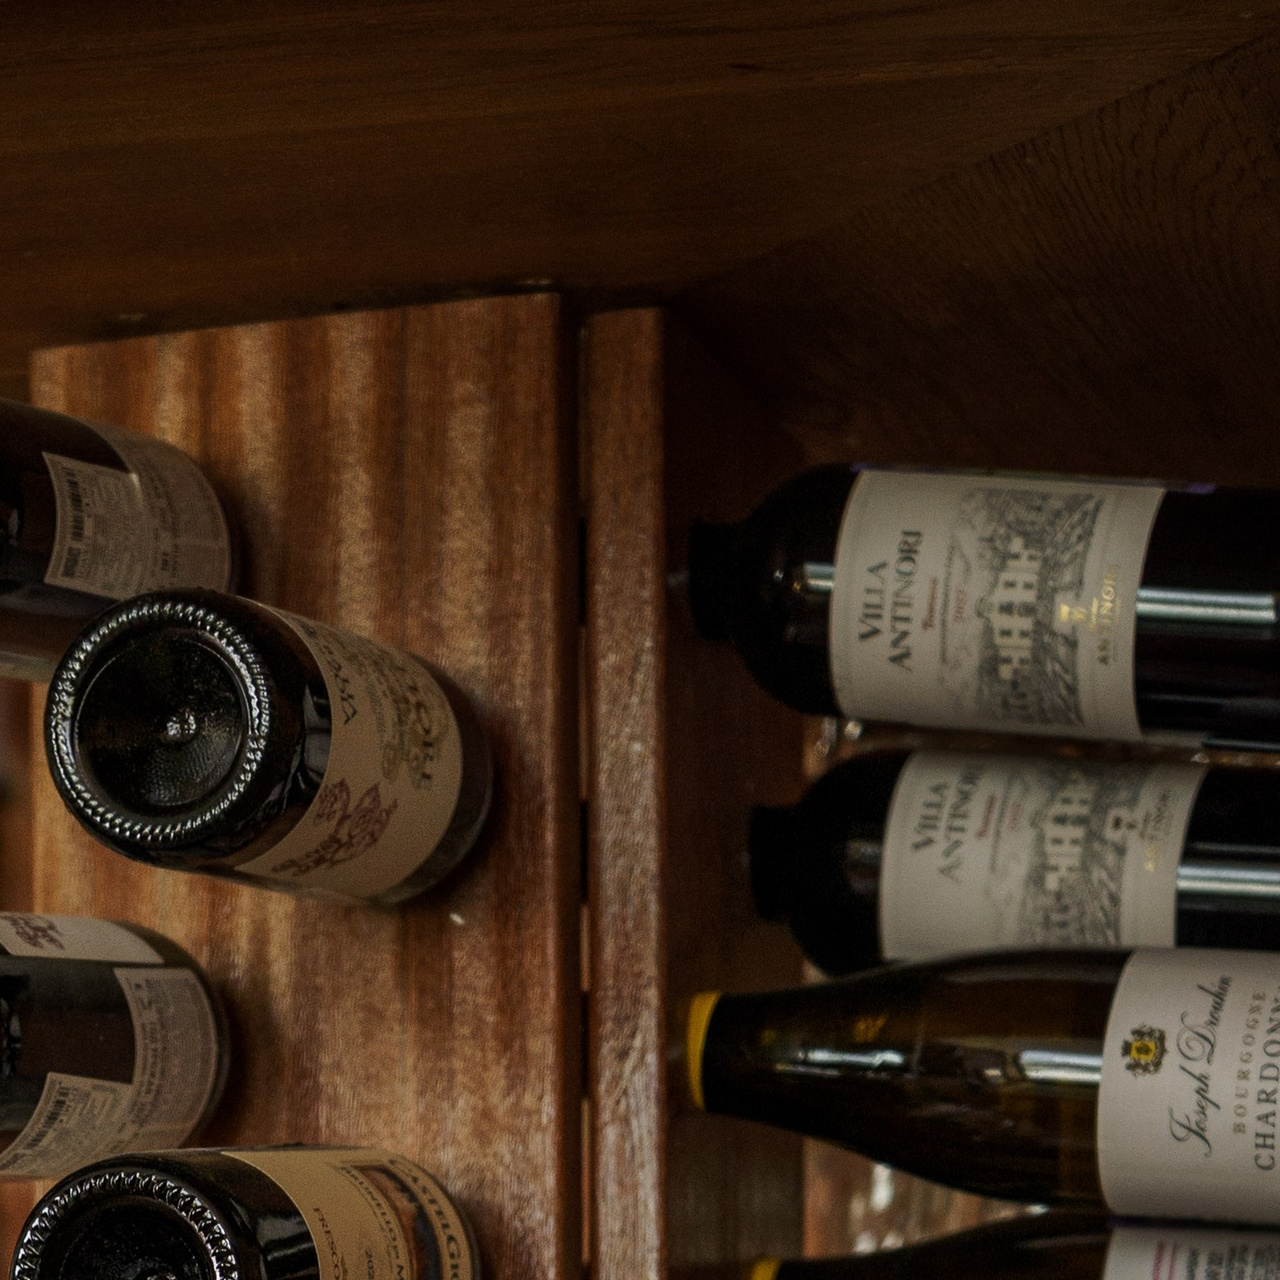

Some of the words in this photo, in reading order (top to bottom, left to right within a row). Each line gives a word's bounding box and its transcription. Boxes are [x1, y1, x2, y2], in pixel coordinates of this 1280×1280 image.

[857, 560, 889, 642] VILLA
[887, 528, 924, 674] ANTINORI
[1180, 974, 1233, 1064] Drouhin
[1231, 990, 1267, 1134] BOURGOGNE
[1169, 1062, 1220, 1157] Joseph
